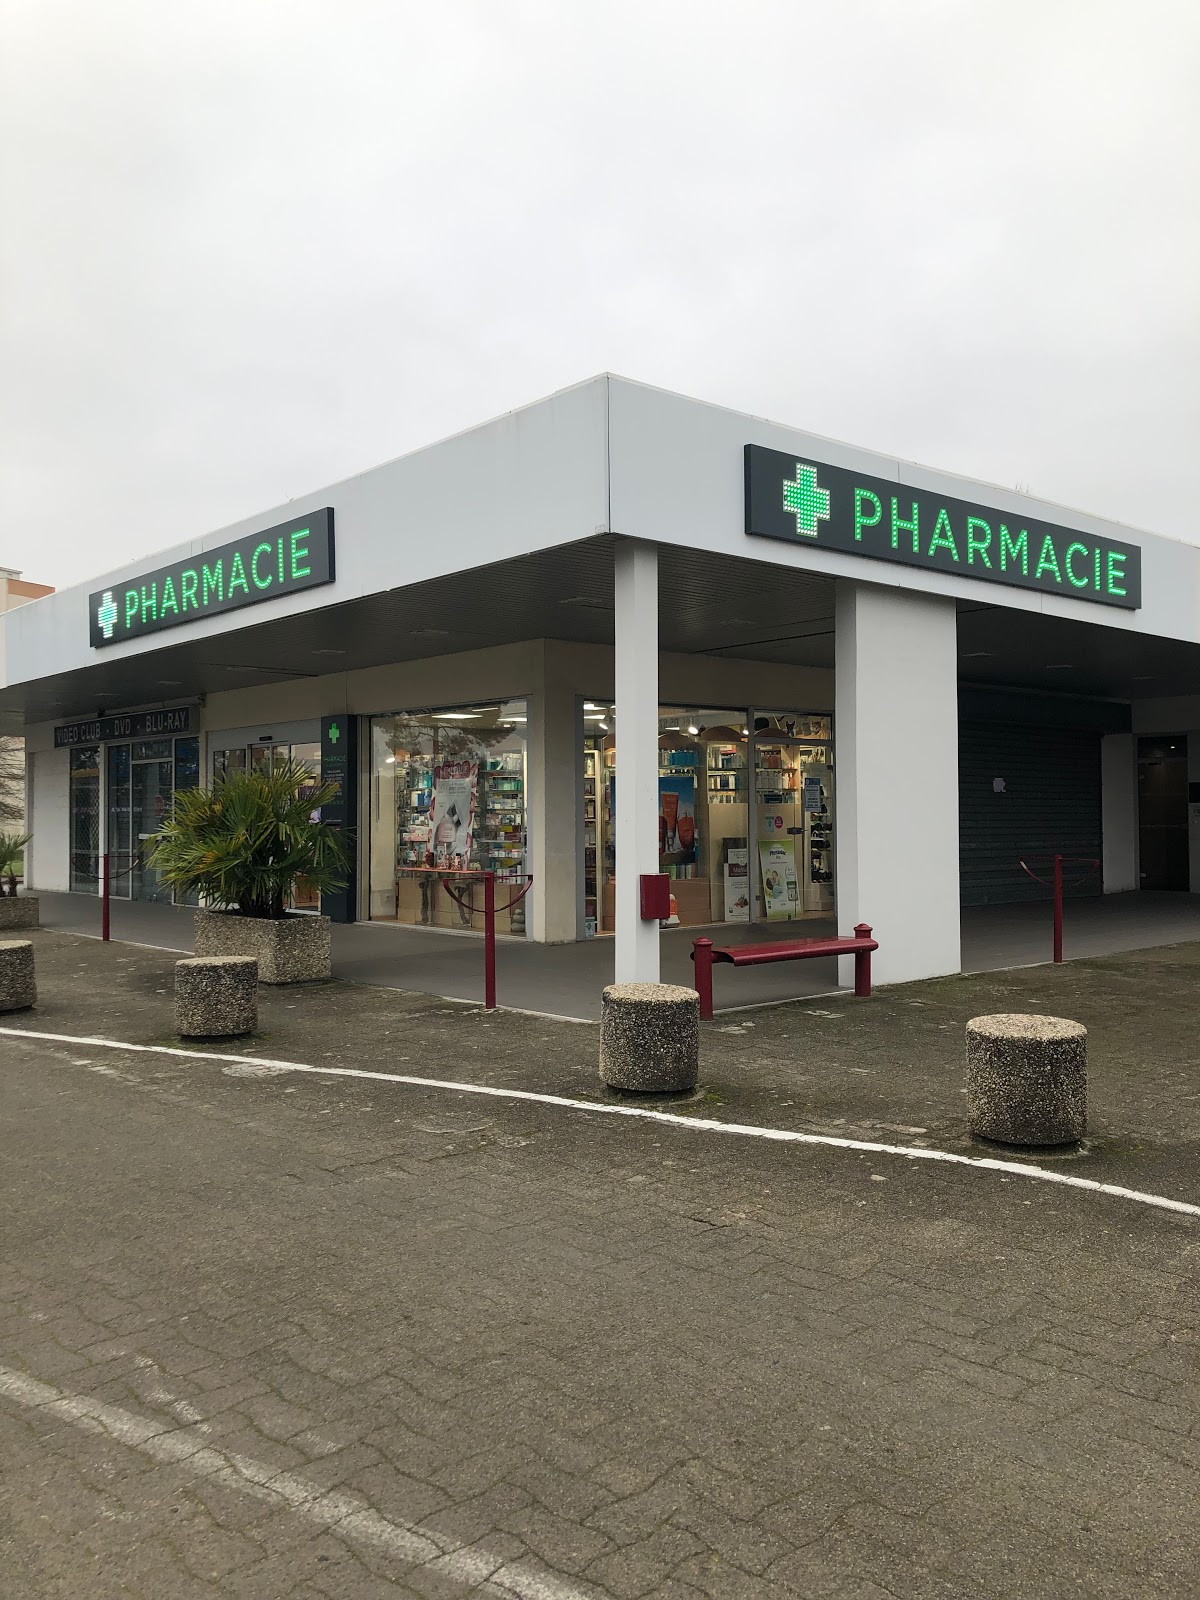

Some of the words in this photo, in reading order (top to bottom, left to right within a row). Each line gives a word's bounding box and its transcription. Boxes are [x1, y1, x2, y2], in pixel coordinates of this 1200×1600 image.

[125, 528, 311, 629] PHARMACIE
[854, 487, 1127, 597] PHARMACIE
[56, 726, 79, 744] VIDEO
[80, 722, 101, 741] CLUB
[114, 718, 131, 736] DVD
[146, 711, 186, 732] BLU-RAY
